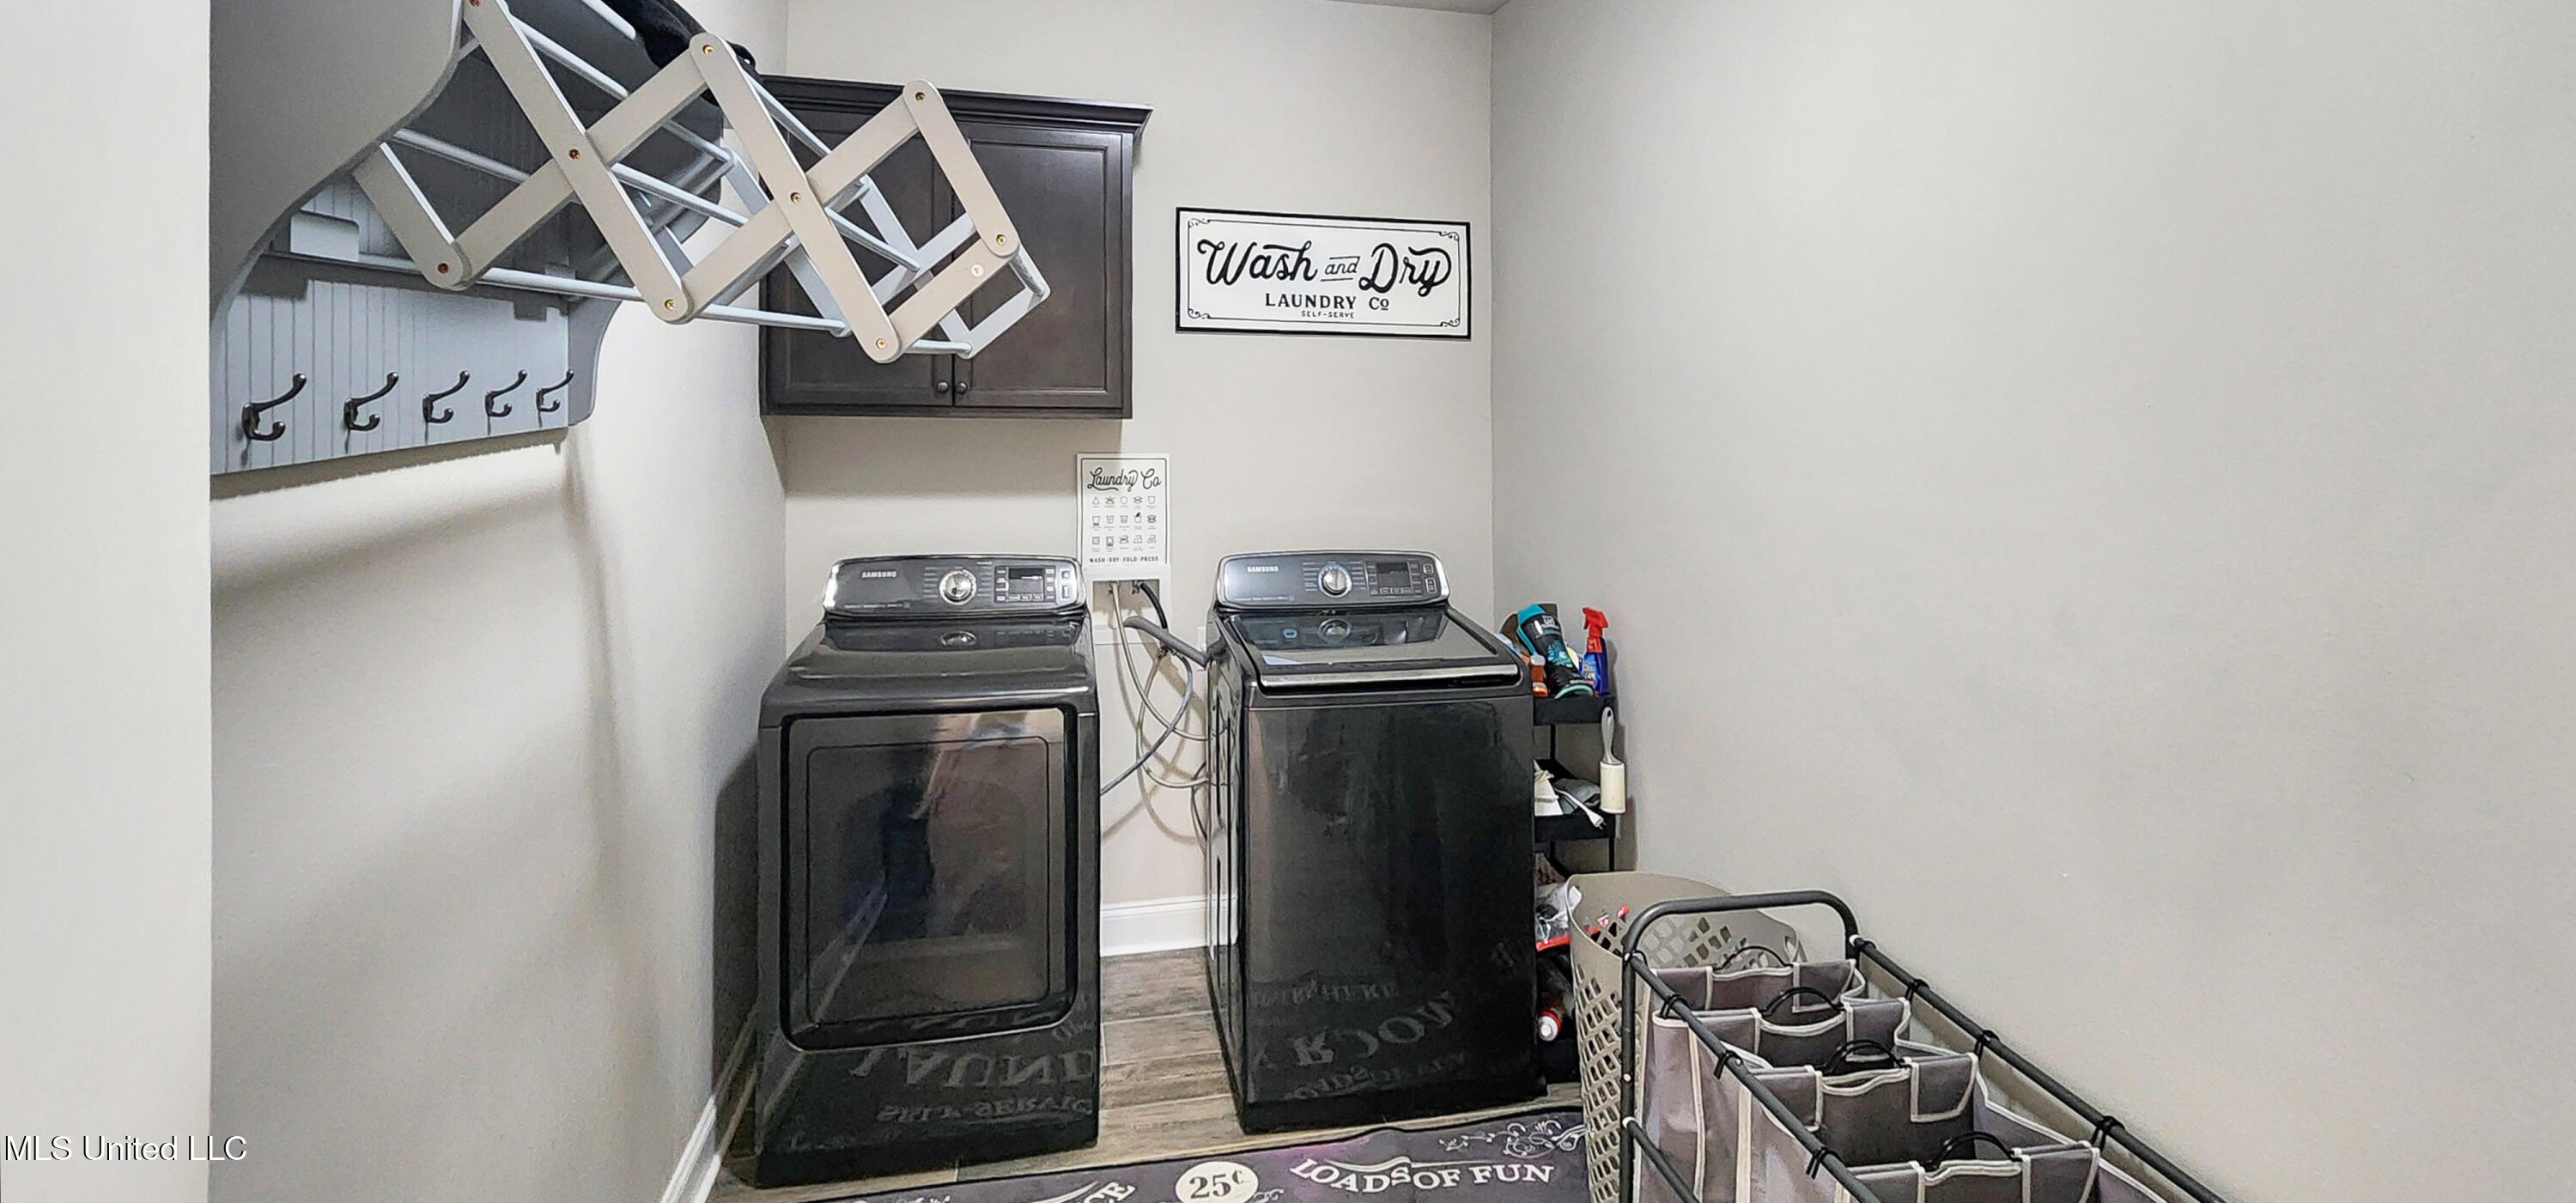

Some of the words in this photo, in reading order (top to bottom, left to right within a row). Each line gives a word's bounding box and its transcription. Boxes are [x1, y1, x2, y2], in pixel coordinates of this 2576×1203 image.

[1197, 240, 1318, 286] Wash
[1324, 257, 1358, 276] and
[1358, 243, 1452, 297] Dry
[1265, 293, 1357, 310] LAUNDRY
[1301, 310, 1355, 319] SELF-SERVE
[1087, 467, 1139, 492] Laundry
[1140, 468, 1162, 489] Co
[1468, 1164, 1554, 1183] FUN
